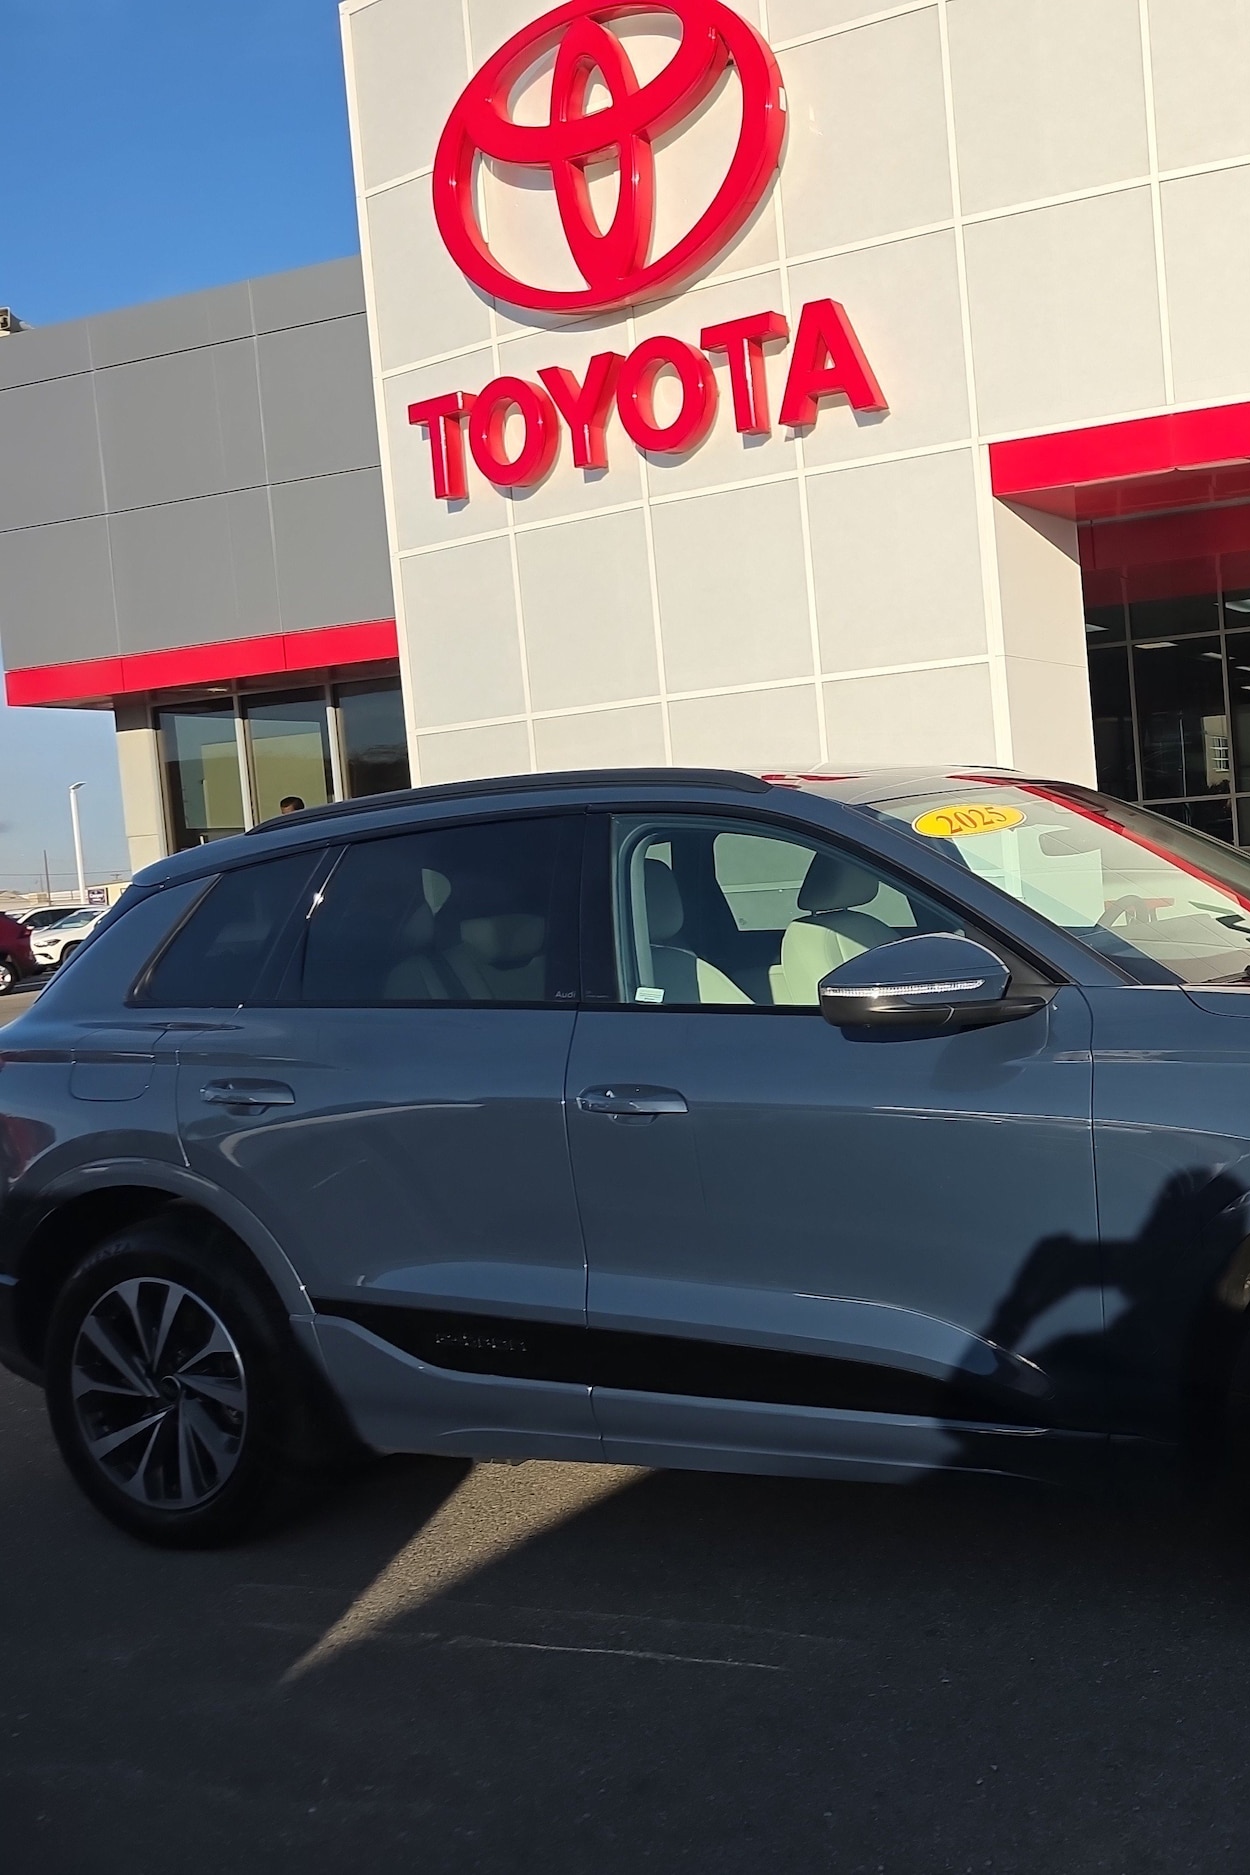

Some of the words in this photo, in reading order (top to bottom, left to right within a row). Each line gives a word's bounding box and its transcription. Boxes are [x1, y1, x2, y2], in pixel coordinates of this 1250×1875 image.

[408, 298, 889, 501] TOYOTA
[936, 807, 1008, 834] 2025
[555, 990, 577, 998] Audi
